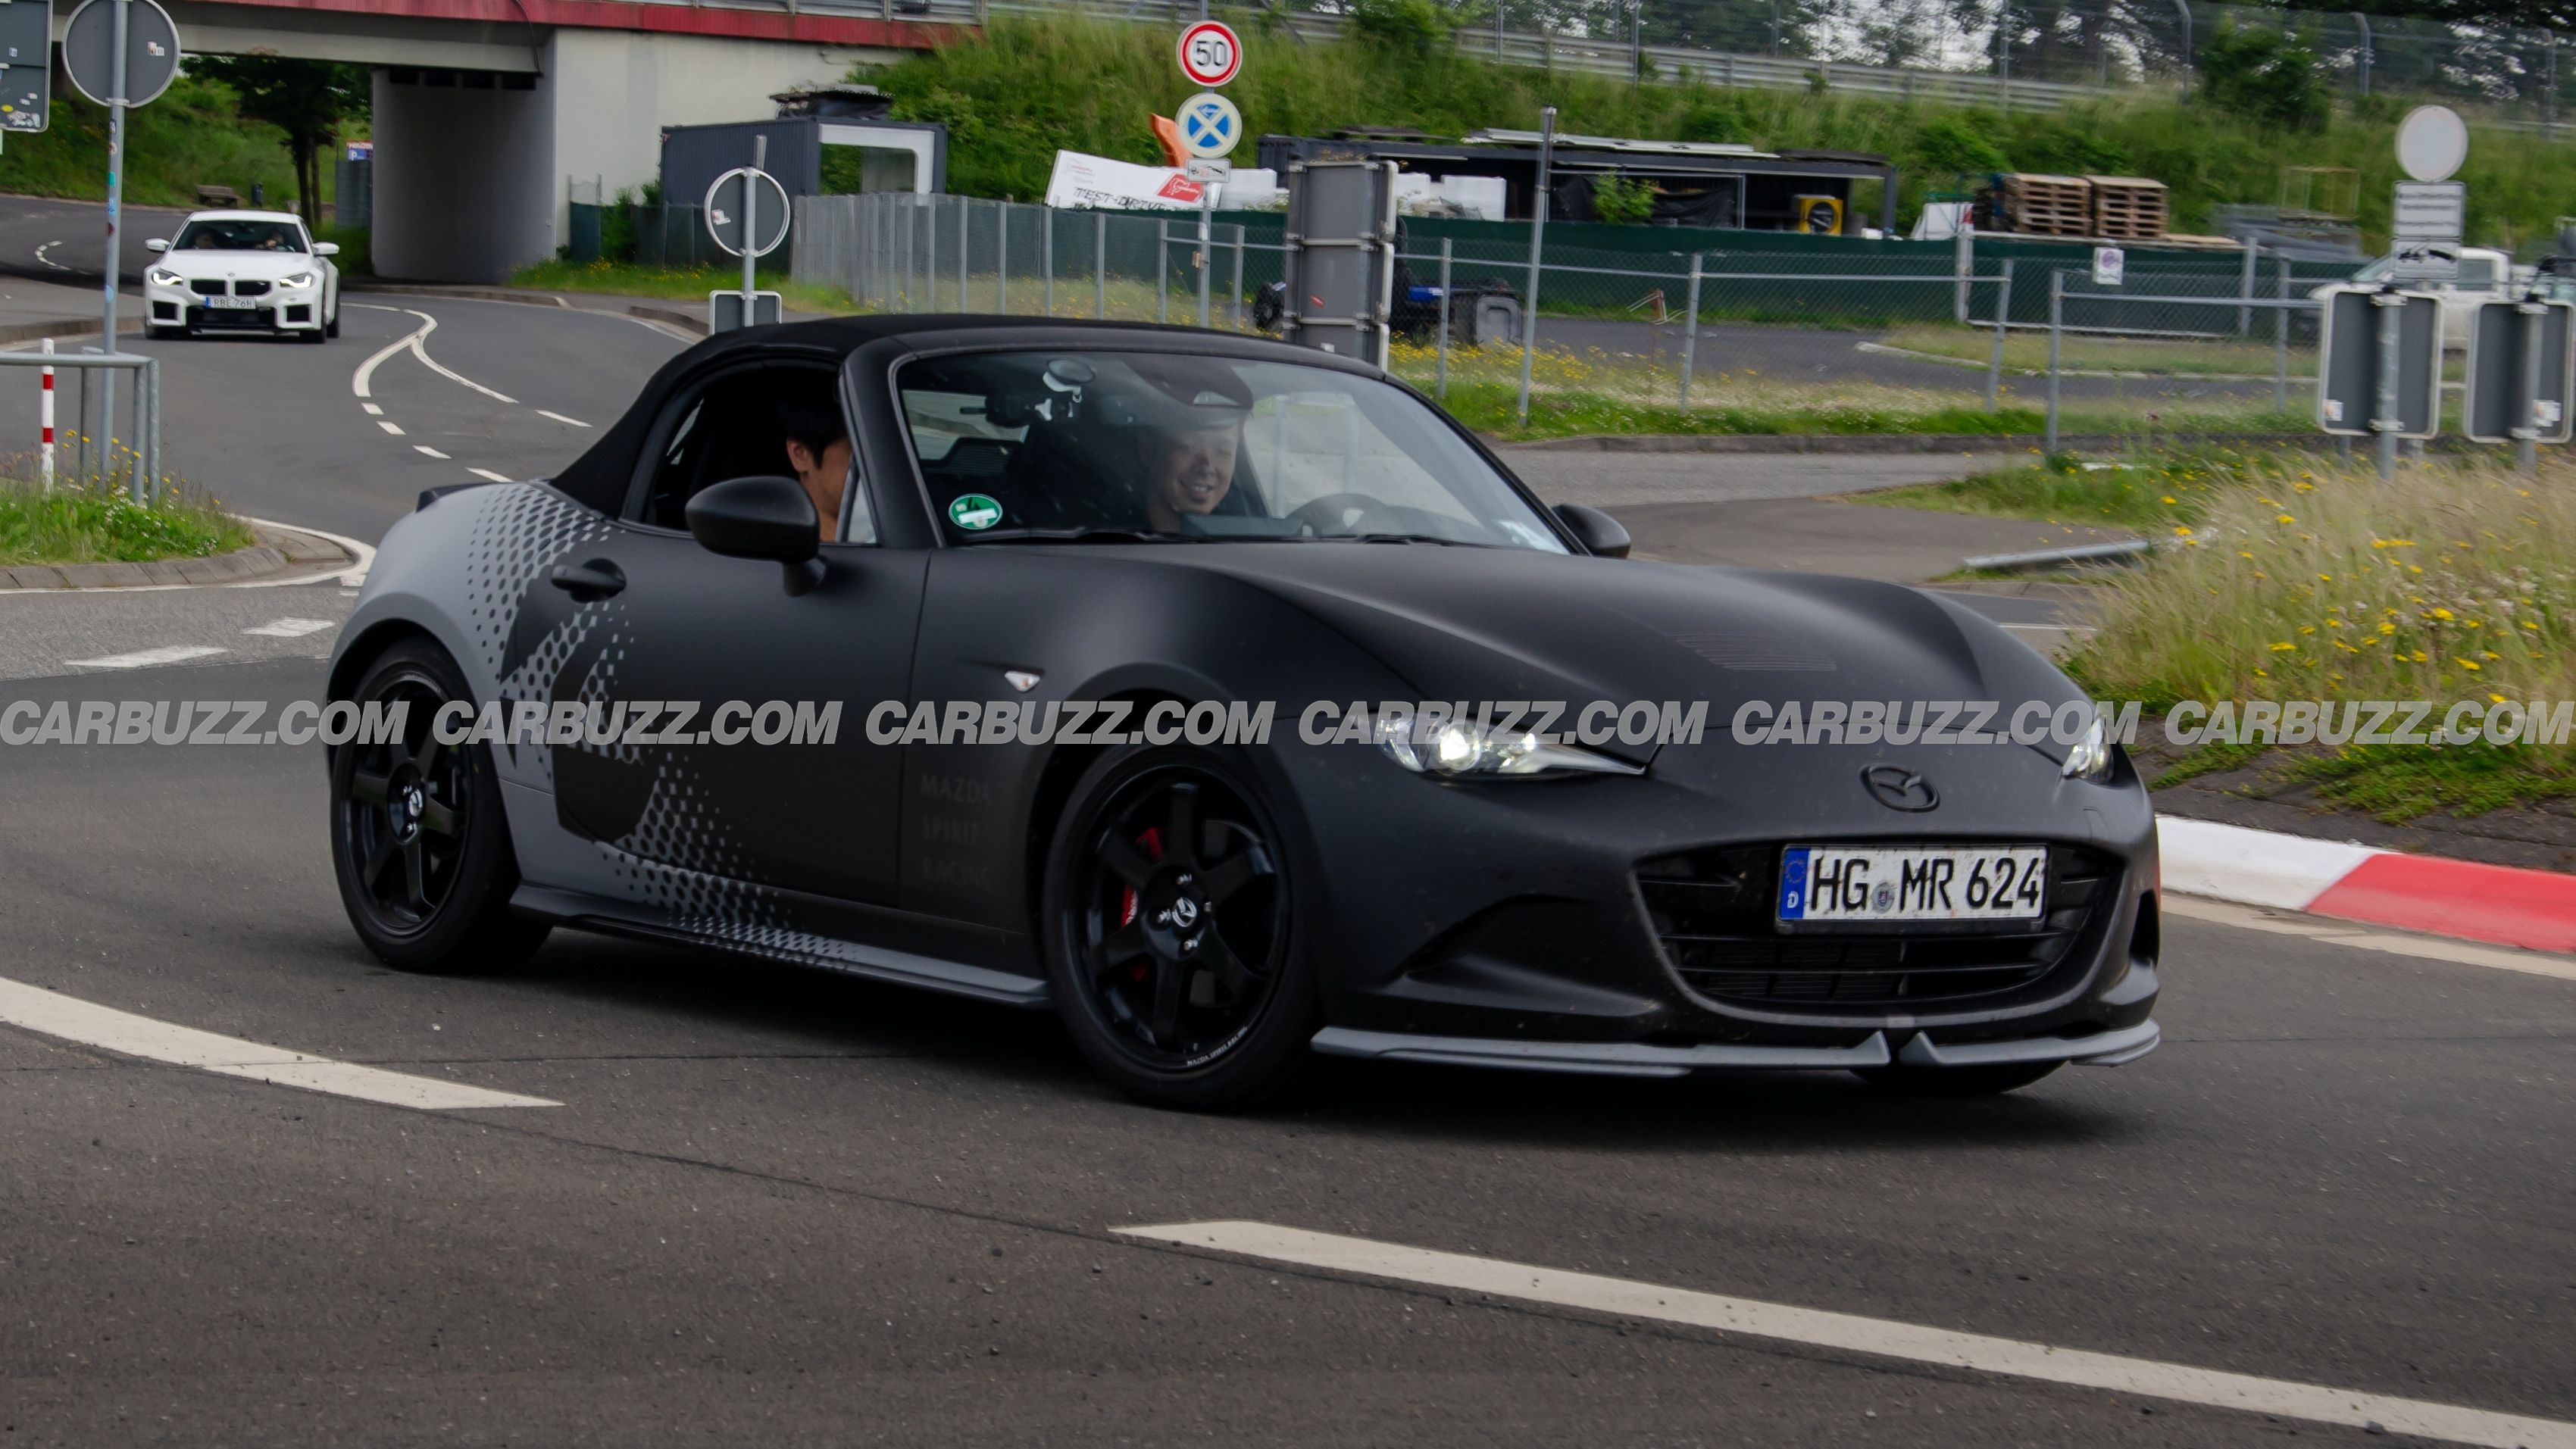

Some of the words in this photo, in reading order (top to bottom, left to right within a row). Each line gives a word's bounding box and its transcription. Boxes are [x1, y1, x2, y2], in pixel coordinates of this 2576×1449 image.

[1196, 40, 1227, 67] 50
[920, 774, 991, 804] MAZDA
[1810, 857, 1869, 910] HG
[1899, 858, 1954, 911] MR
[1966, 857, 2040, 910] 624
[1787, 892, 1799, 908] D
